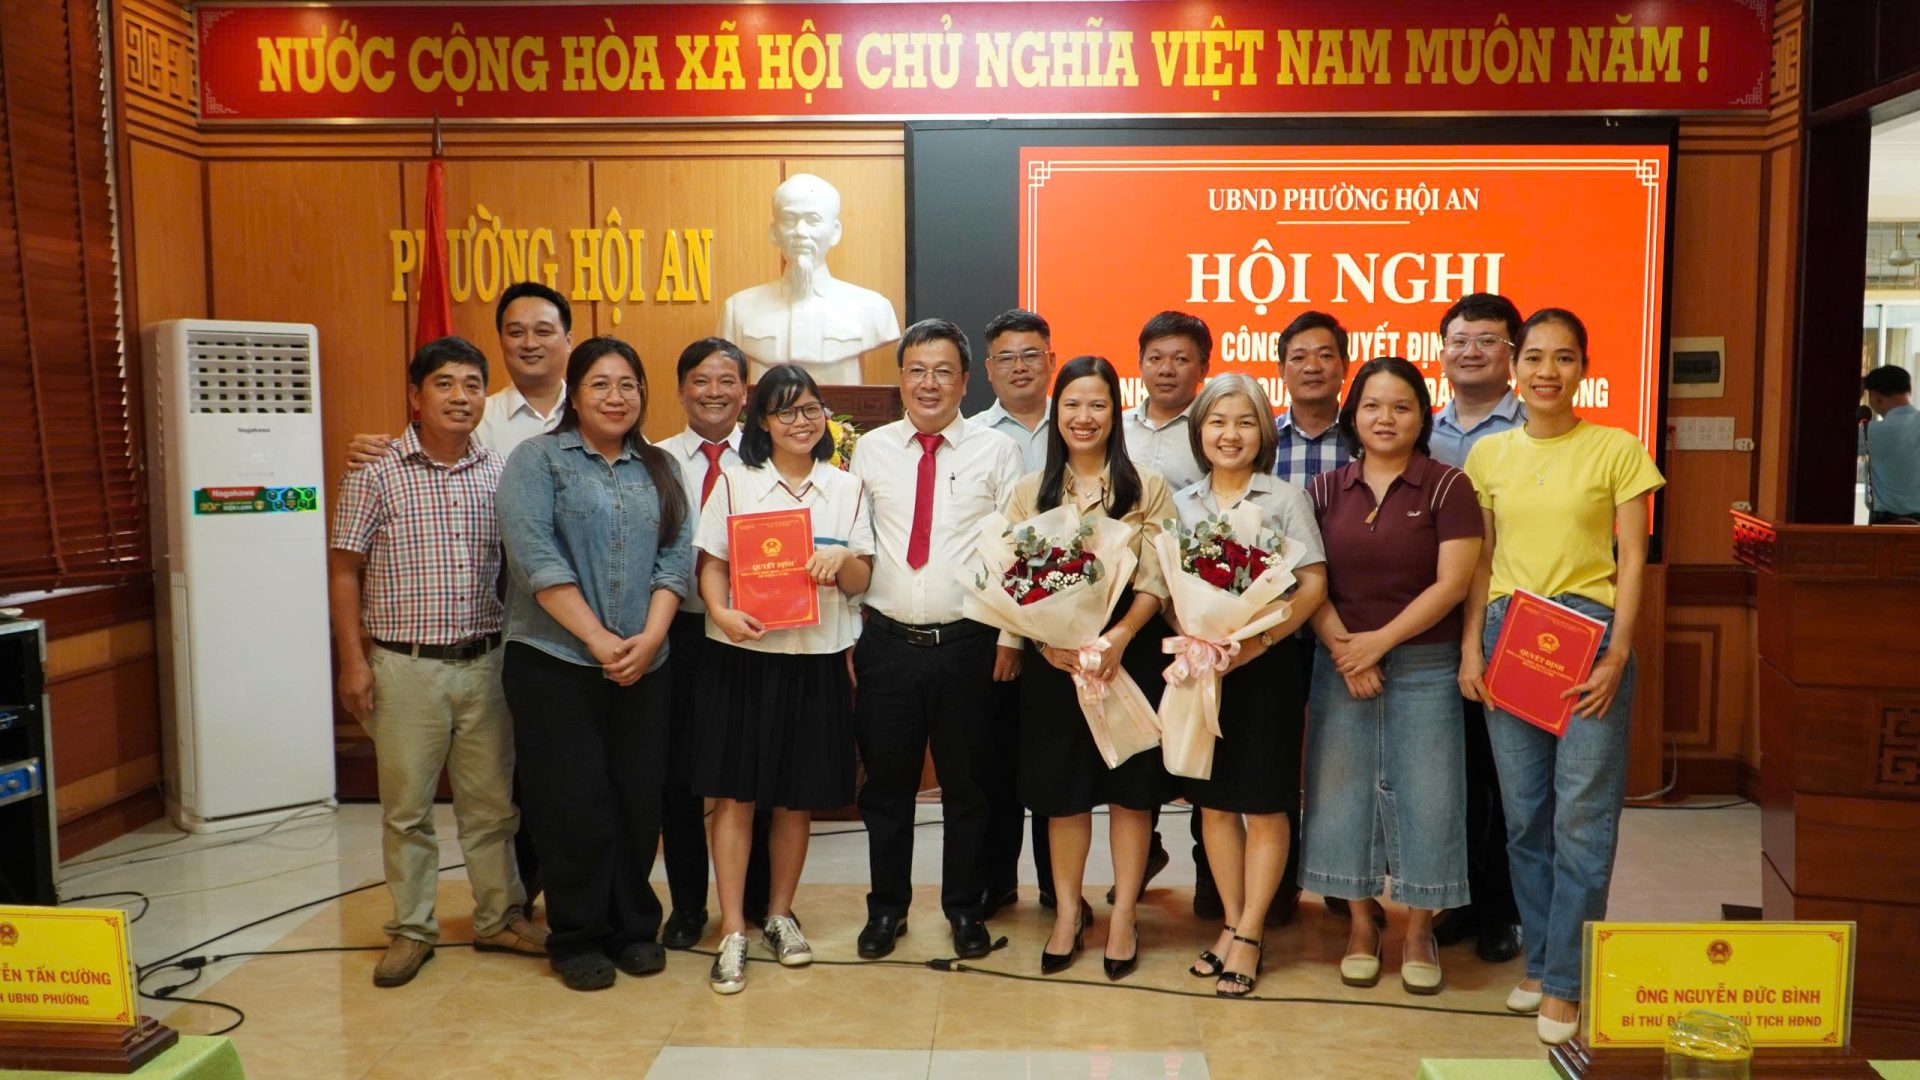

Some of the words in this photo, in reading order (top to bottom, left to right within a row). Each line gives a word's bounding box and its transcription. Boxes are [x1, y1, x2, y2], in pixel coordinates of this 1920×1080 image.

[258, 20, 395, 93] NƯỚC
[407, 22, 549, 106] CỘNG
[562, 18, 664, 91] HÒA
[675, 21, 745, 90] XÃ
[757, 20, 843, 104] HỘI
[856, 13, 963, 89] CHỦ
[976, 17, 1139, 88] NGHĨA
[1151, 15, 1266, 101] VIỆT
[1277, 29, 1391, 85] NAM
[1406, 14, 1555, 84] MUÔN
[1568, 13, 1682, 83] NĂM
[1208, 188, 1277, 211] UBND
[1283, 181, 1388, 211] PHƯỜNG
[1396, 182, 1439, 216] HỘI
[1445, 188, 1480, 210] AN
[570, 206, 644, 325] HỘI
[656, 229, 713, 301] AN
[1186, 238, 1311, 316] HỘI
[1221, 325, 1281, 363] CÔNG
[1346, 321, 1400, 362] UYẾT
[212, 490, 255, 498] Nagakawa
[26, 965, 56, 983] TẤN
[60, 968, 112, 985] CƯỜNG
[8, 993, 39, 1004] UBND
[43, 993, 89, 1006] PHƯỜNG
[1636, 985, 1668, 1004] ÔNG
[1674, 982, 1737, 1004] NGUYỄN
[1743, 986, 1777, 1004] ĐỨC
[1782, 985, 1821, 1004] BÌNH
[1639, 1014, 1664, 1027] THƯ
[1757, 1015, 1783, 1030] TỊCH
[1788, 1015, 1822, 1027] HĐND
